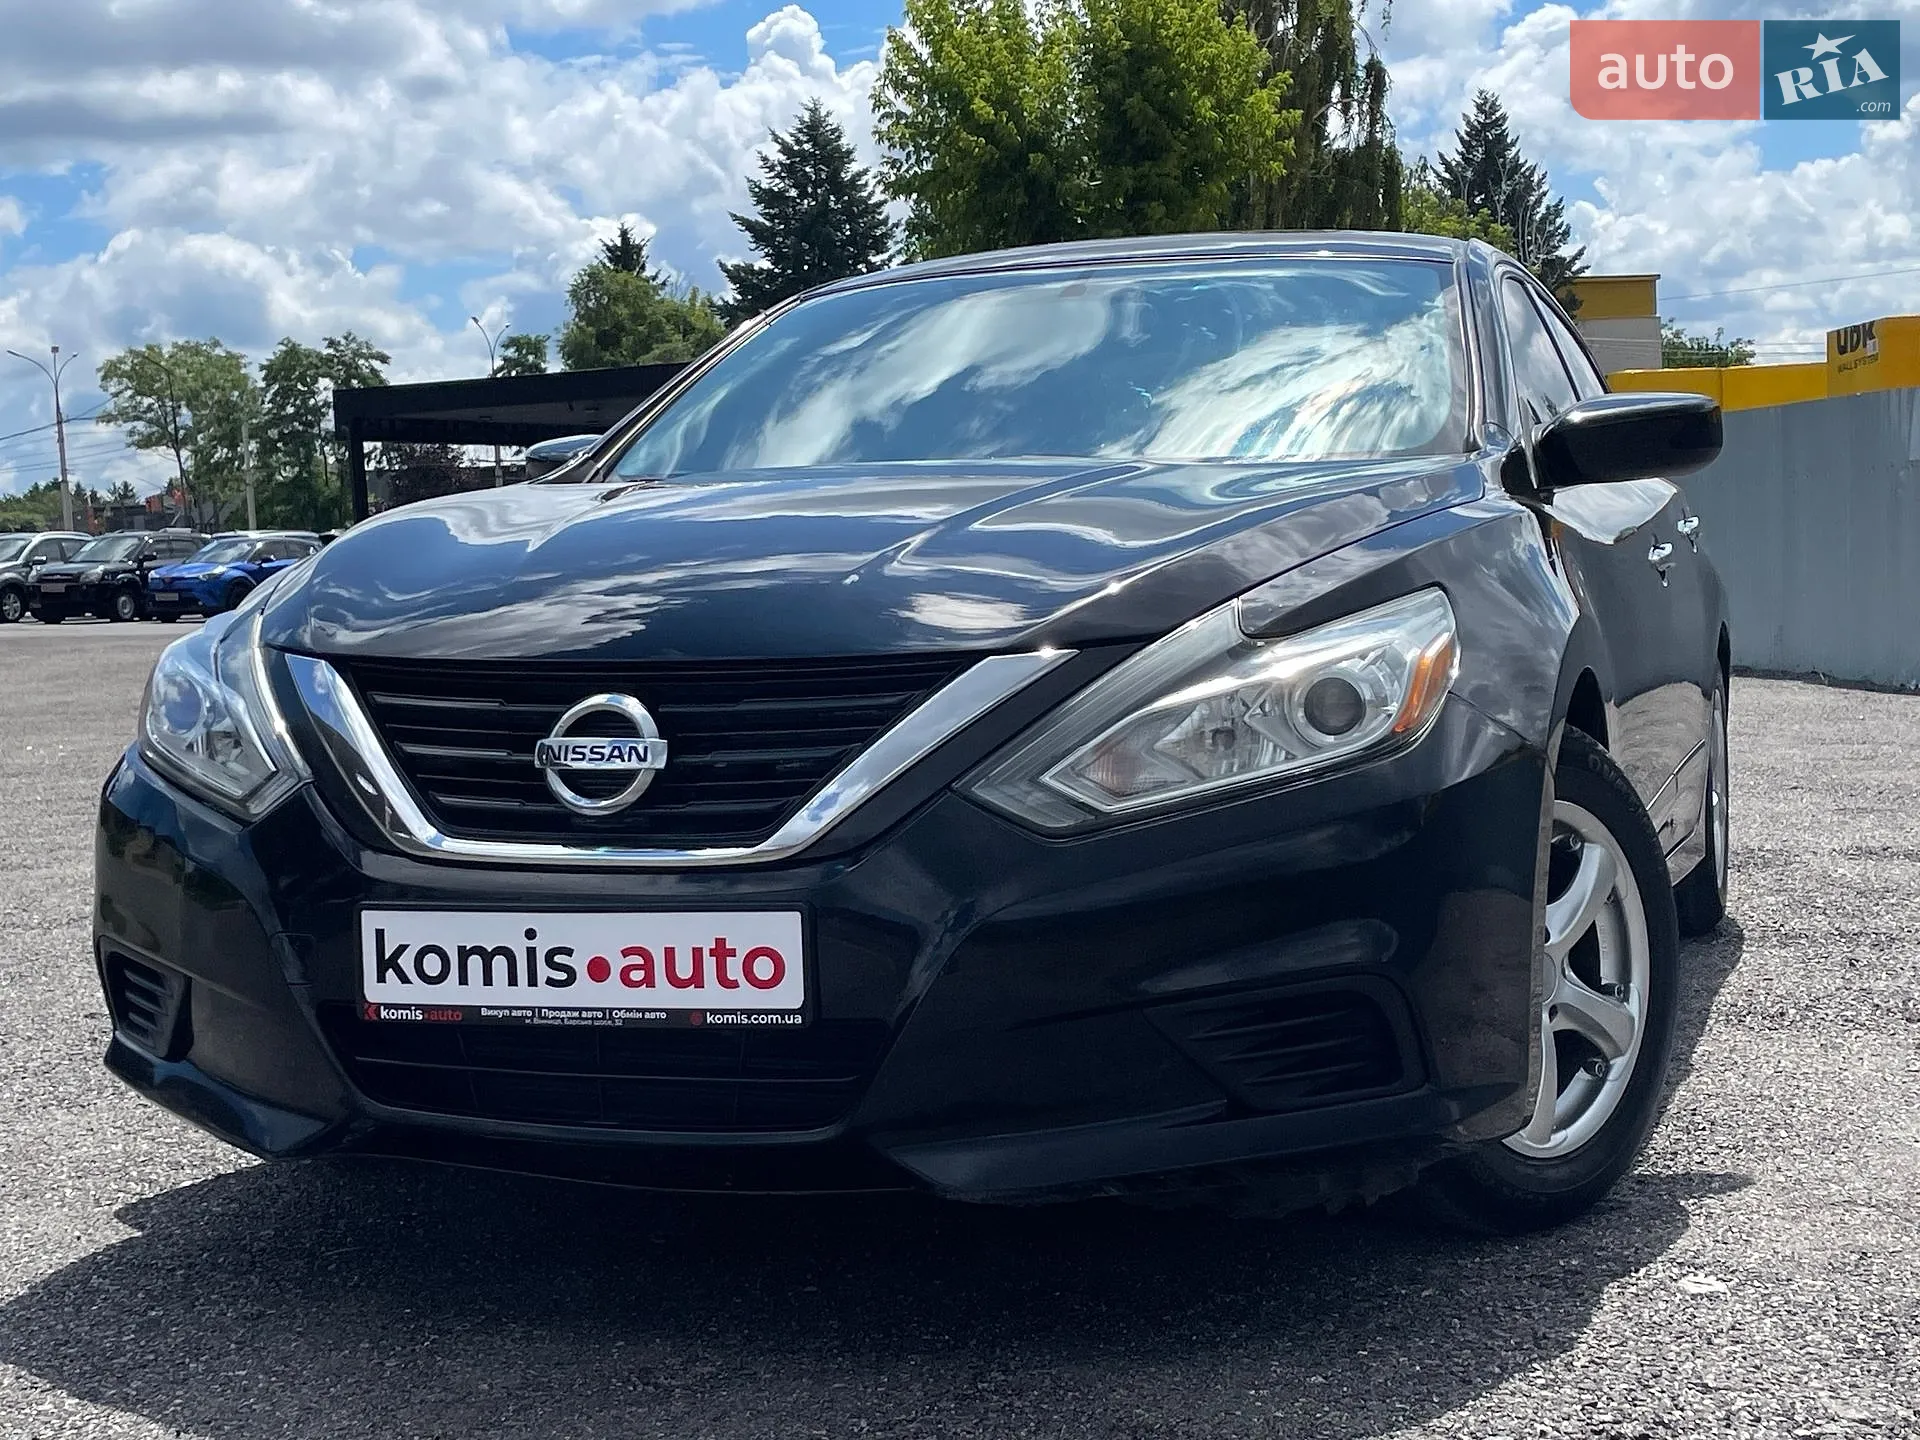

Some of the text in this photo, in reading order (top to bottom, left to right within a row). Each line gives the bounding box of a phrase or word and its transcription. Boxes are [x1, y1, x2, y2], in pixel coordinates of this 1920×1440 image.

[546, 745, 649, 763] NISSAN
[481, 1008, 667, 1019] Викуп авто Продаж авто Обмін авто
[706, 1011, 802, 1024] komis.com.ua
